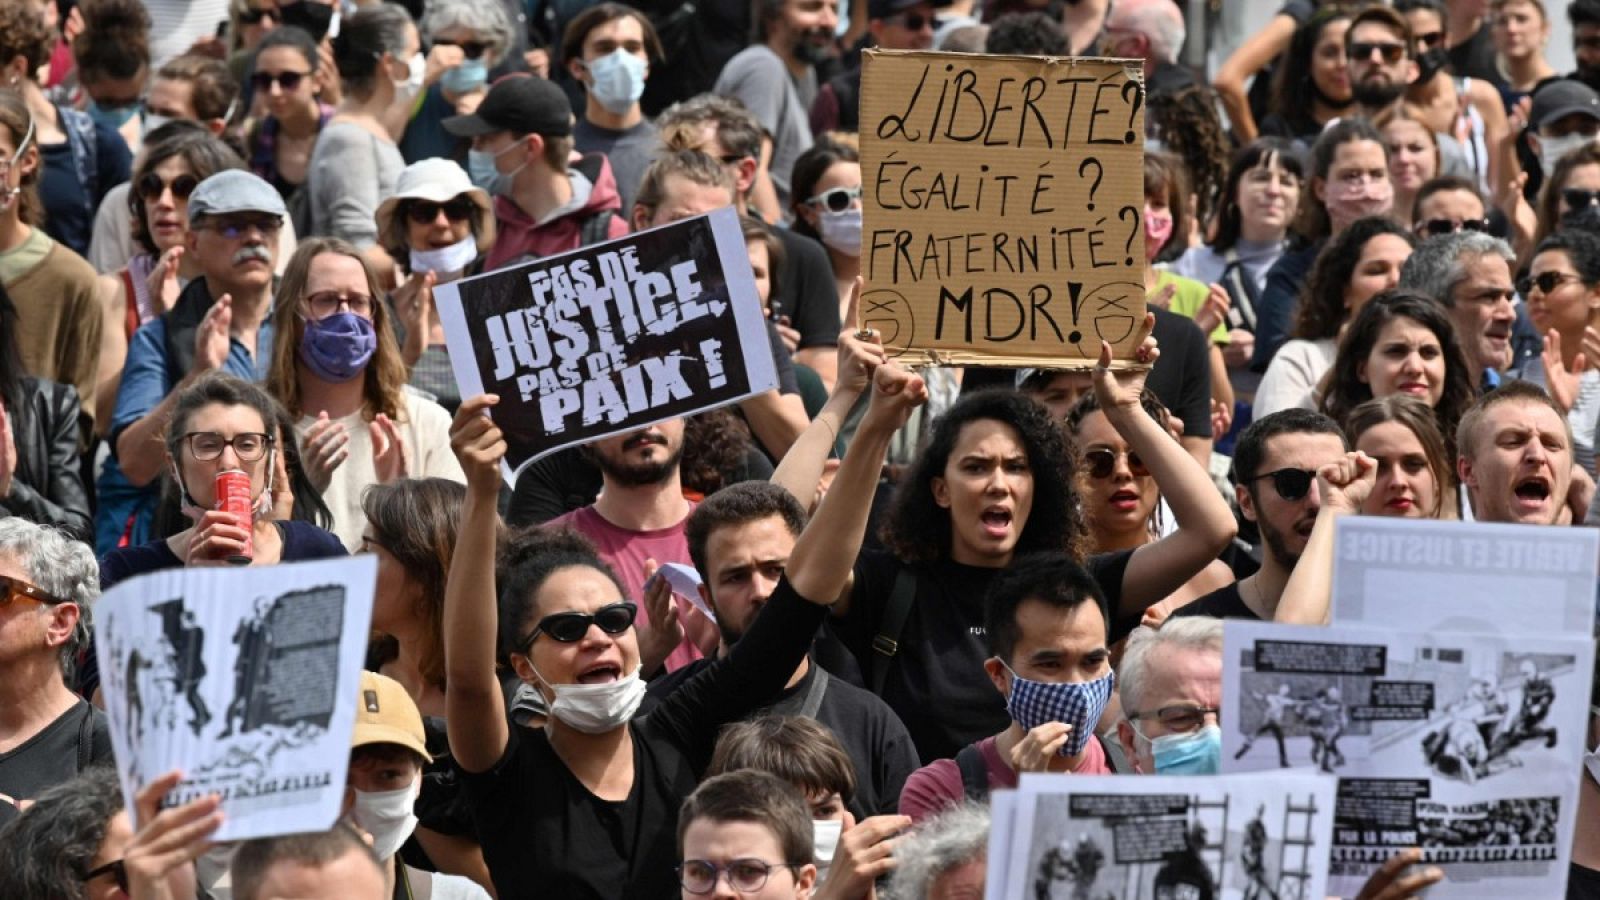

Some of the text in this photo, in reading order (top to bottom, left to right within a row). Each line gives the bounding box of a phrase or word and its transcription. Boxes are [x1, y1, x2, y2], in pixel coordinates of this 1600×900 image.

[528, 245, 641, 306] PAS DE
[935, 281, 1083, 344] MDR!
[517, 350, 628, 402] PAS DE
[539, 350, 698, 436] PAIX
